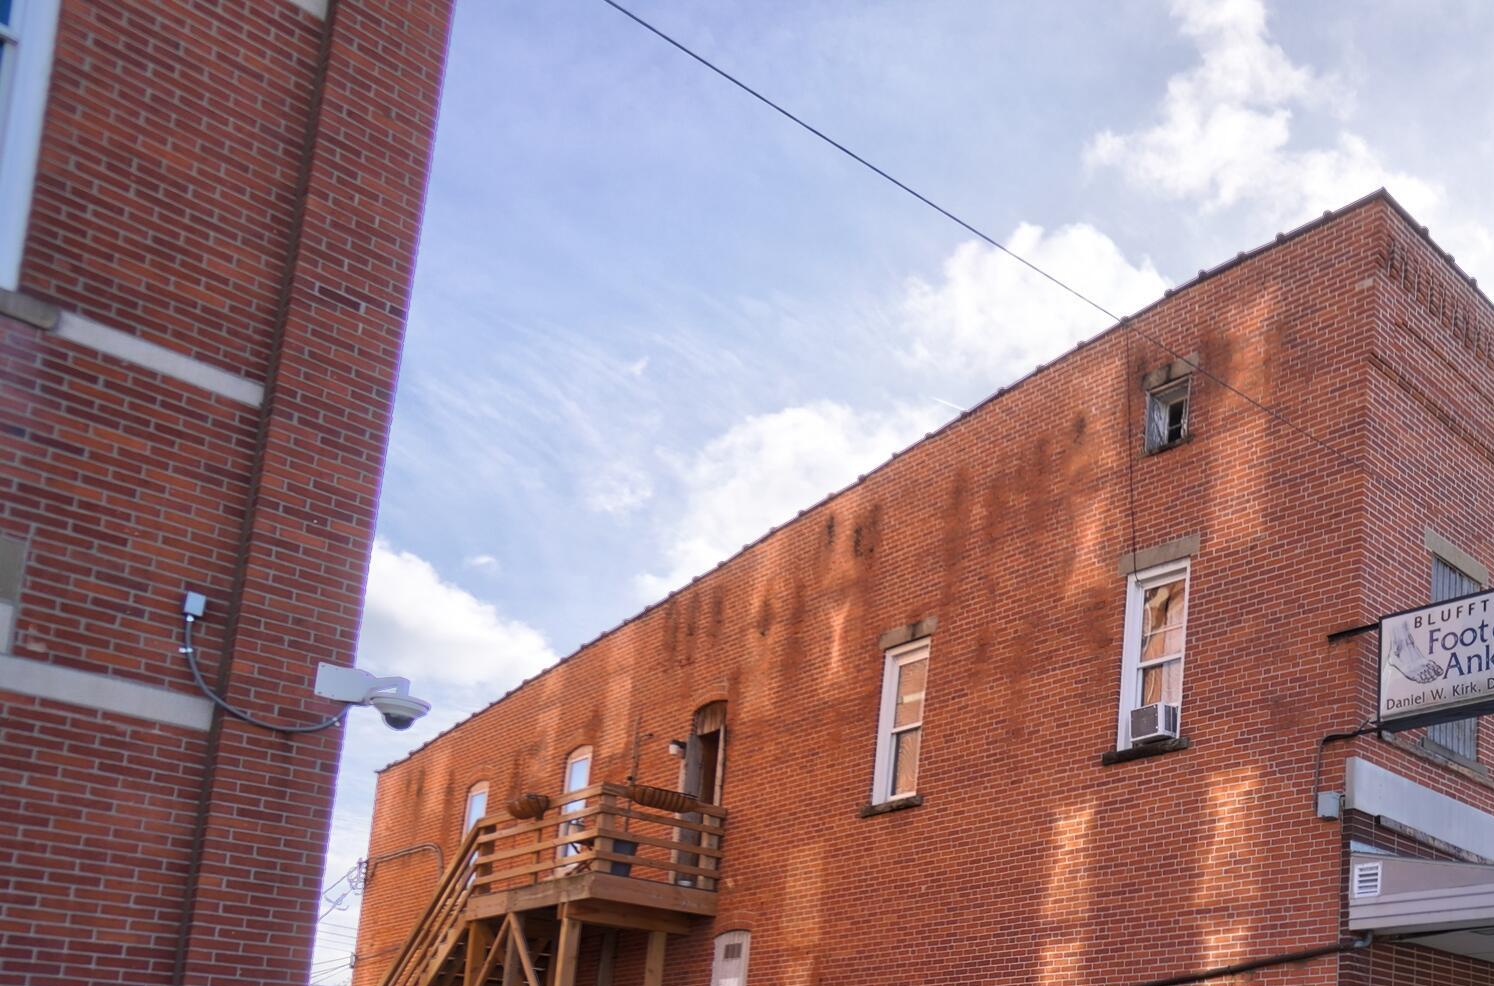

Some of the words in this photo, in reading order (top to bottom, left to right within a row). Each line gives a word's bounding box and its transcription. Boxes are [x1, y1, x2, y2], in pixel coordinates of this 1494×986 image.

[1428, 619, 1489, 655] Foot
[1386, 691, 1426, 711] Daniel
[1430, 687, 1448, 702] W.
